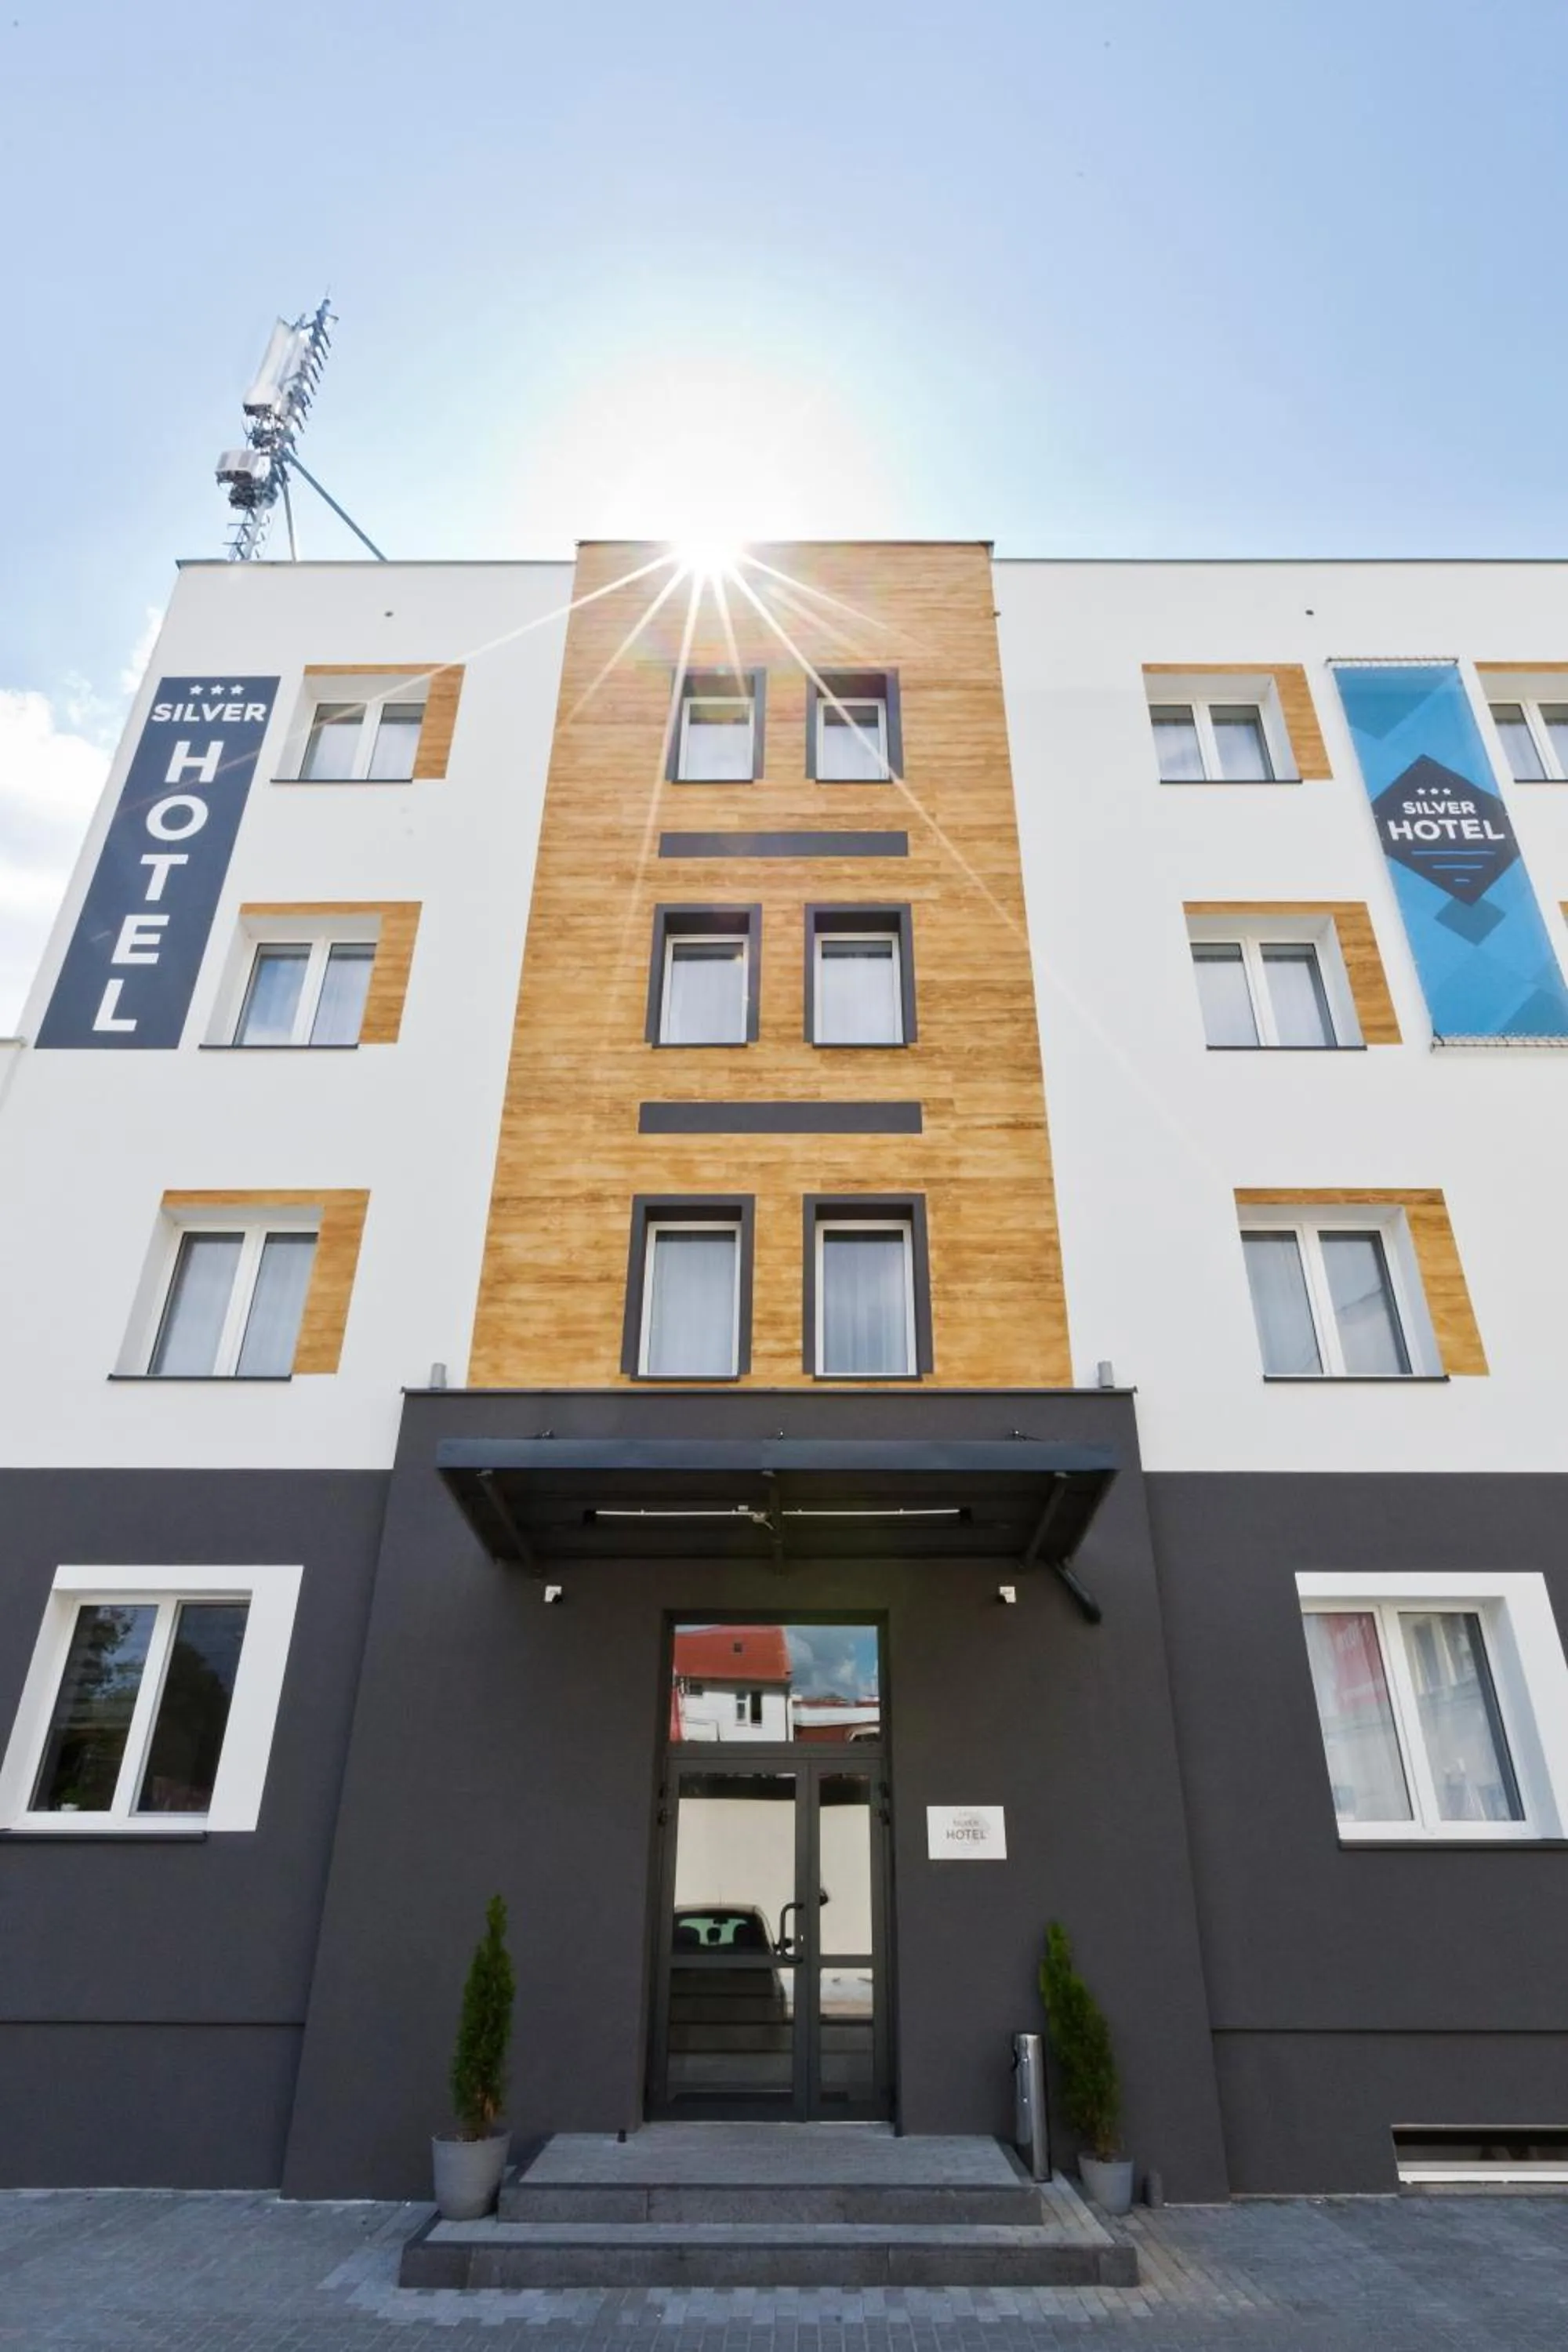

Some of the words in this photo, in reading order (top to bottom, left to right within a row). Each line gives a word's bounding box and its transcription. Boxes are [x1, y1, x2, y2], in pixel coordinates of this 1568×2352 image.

[152, 703, 266, 722] SILVER
[1402, 800, 1475, 815] SILVER
[1387, 819, 1504, 840] HOTEL
[93, 741, 223, 1031] HOTEL
[946, 1829, 986, 1840] HOTEL
